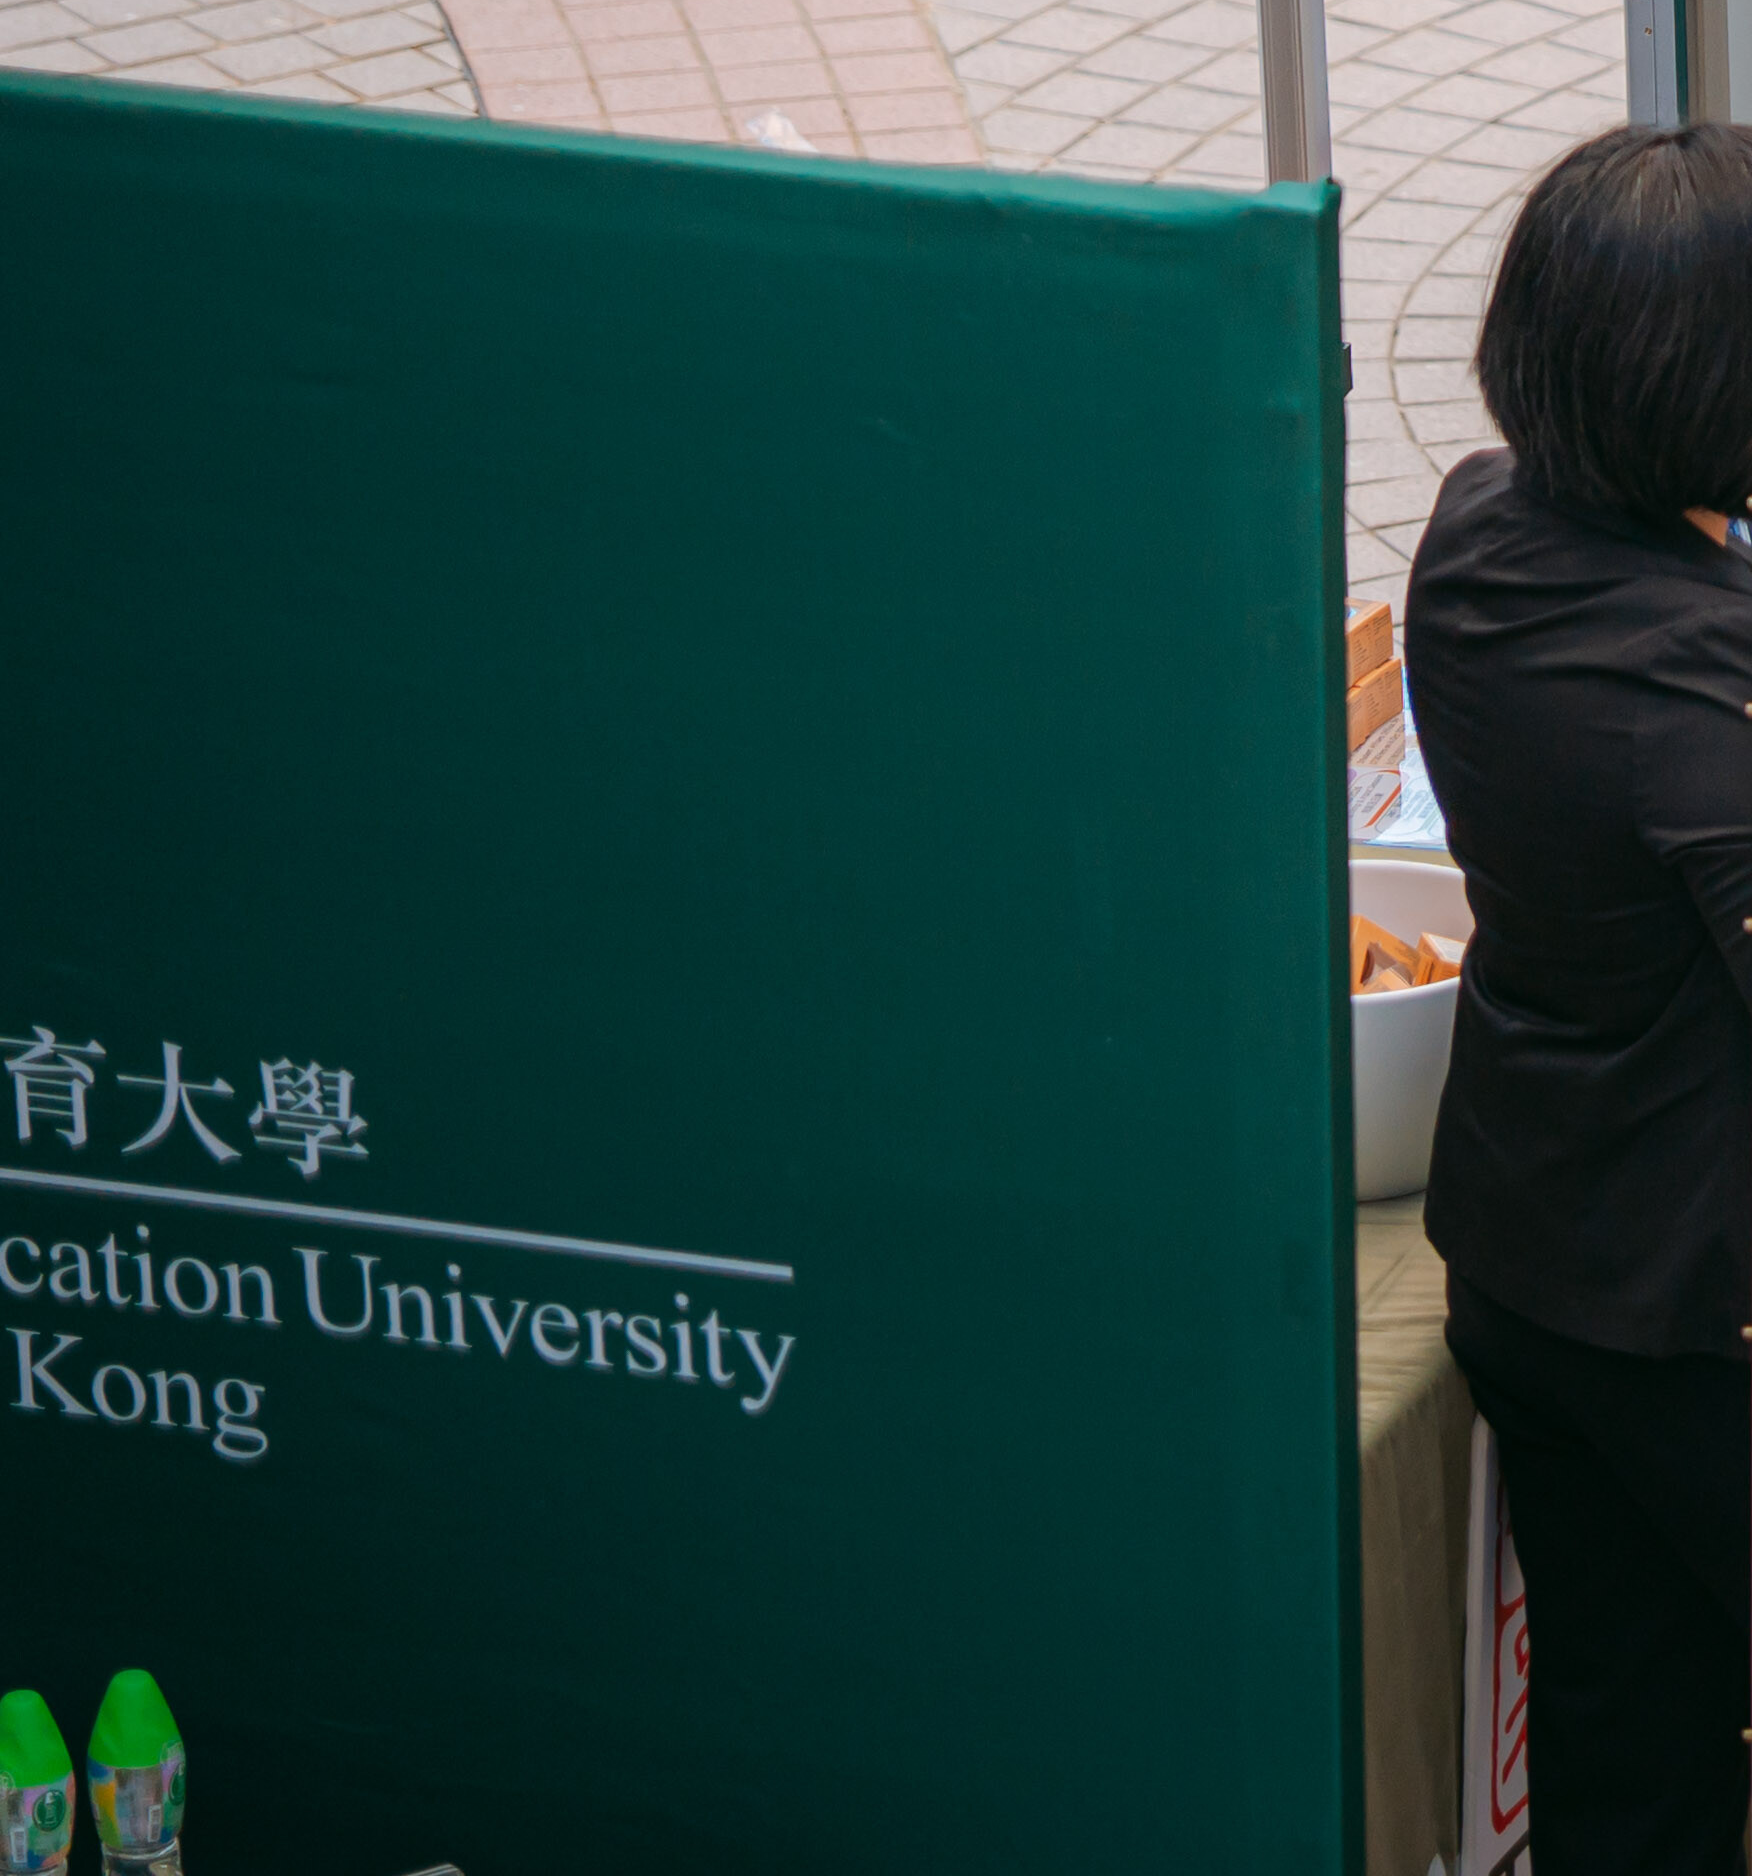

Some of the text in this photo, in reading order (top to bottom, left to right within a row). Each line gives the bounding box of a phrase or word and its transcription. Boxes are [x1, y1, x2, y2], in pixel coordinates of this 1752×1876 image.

[0, 1024, 370, 1178] 育大學
[0, 1223, 797, 1416] cation University
[8, 1329, 270, 1461] Kong
